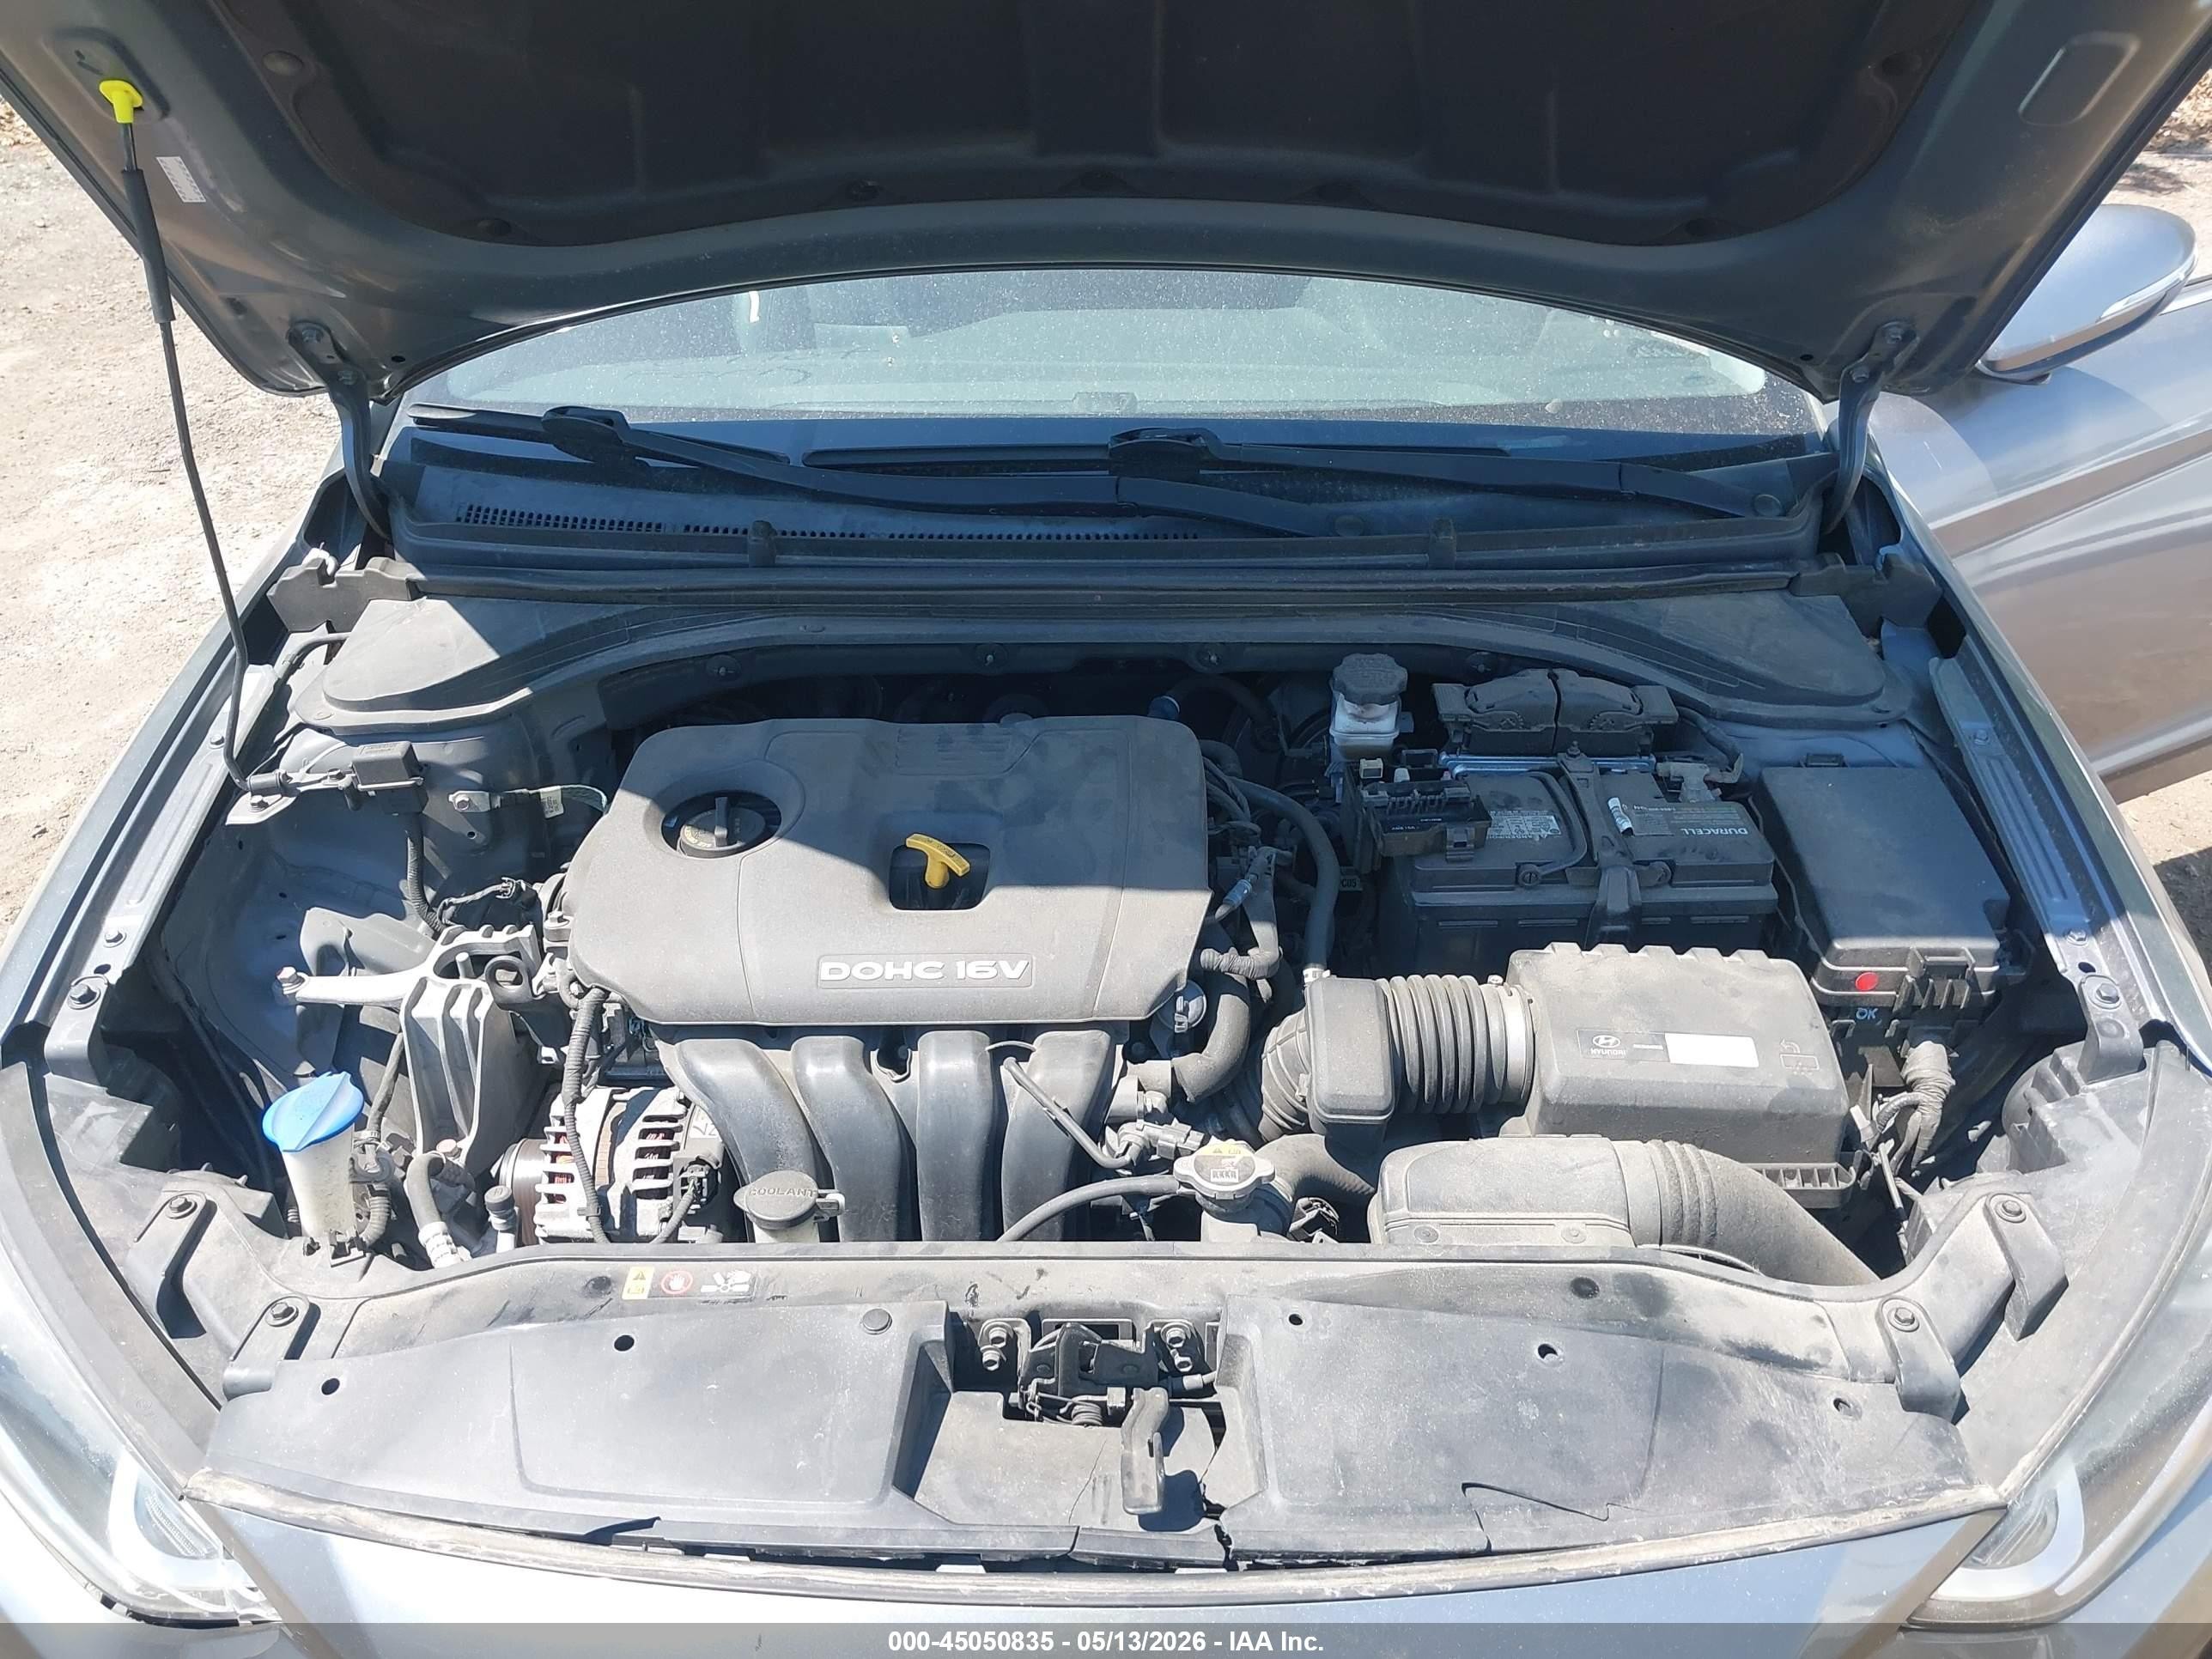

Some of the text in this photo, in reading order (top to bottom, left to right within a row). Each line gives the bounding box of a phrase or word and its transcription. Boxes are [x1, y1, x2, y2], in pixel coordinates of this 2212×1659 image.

[1680, 827, 1749, 836] DURACELL
[820, 960, 1030, 981] DOHC 16V
[1856, 1007, 1879, 1020] OK
[1589, 1048, 1628, 1056] HYUNDAI
[749, 1188, 814, 1197] COOLANT
